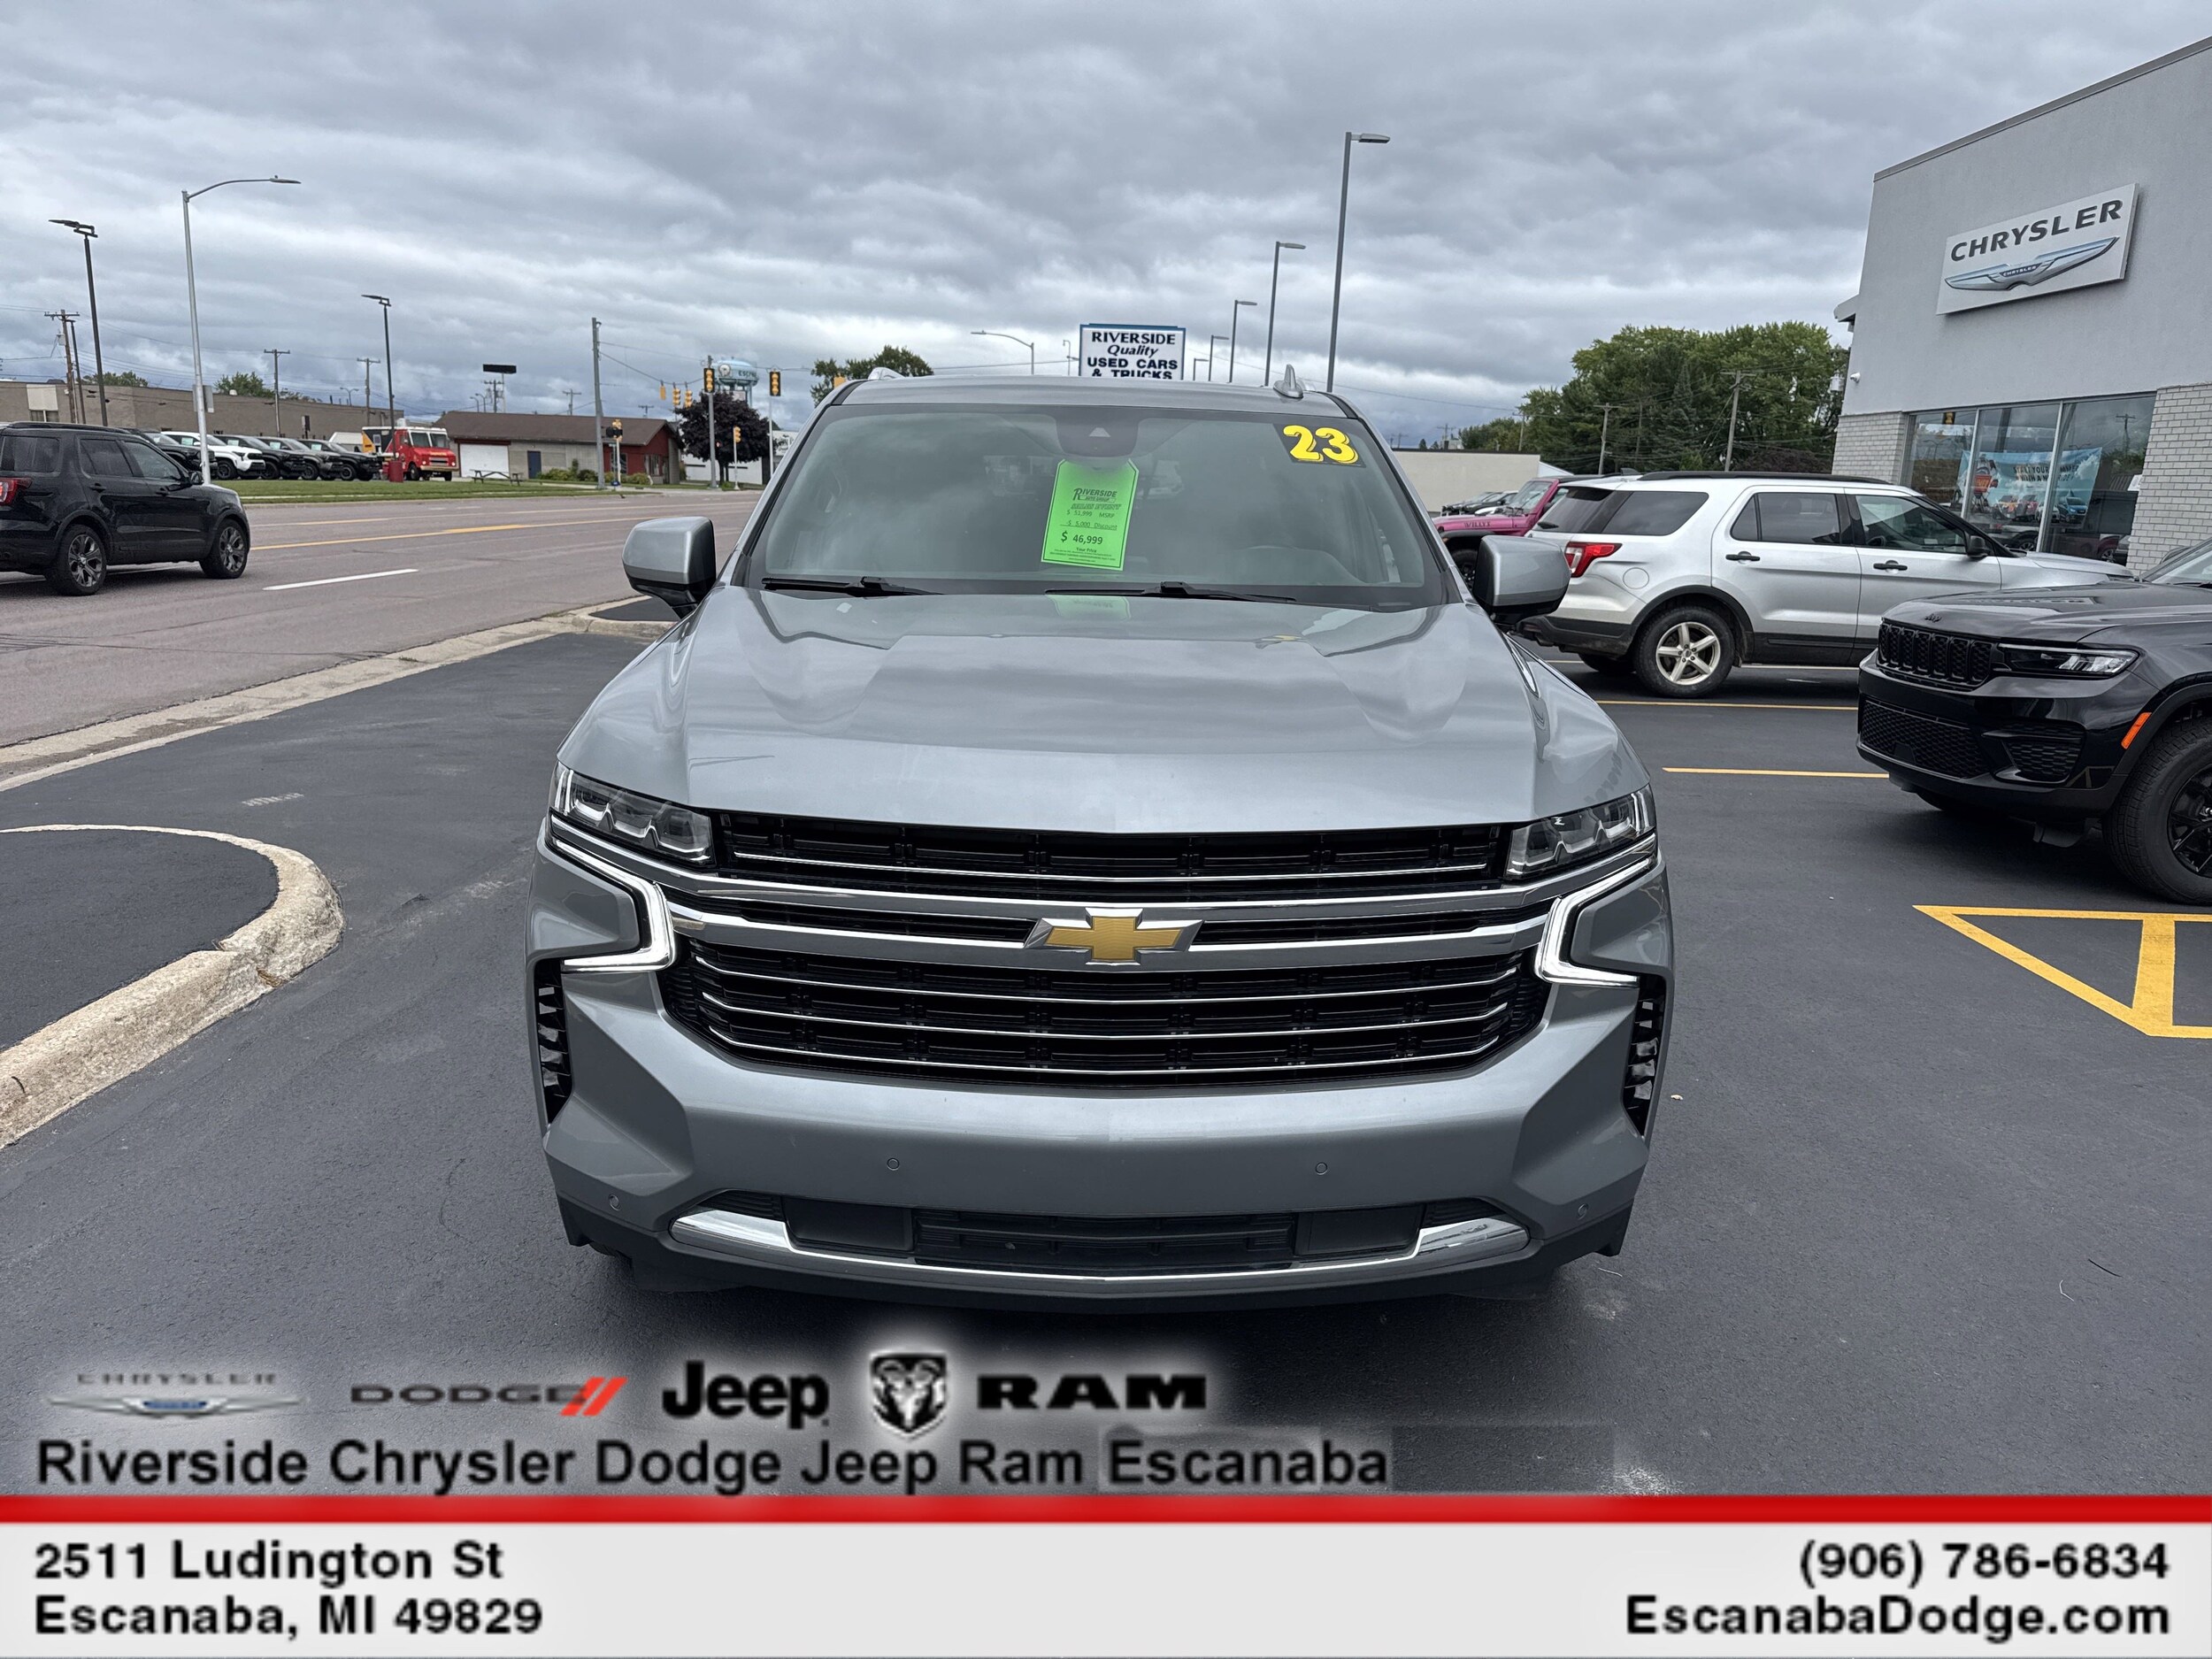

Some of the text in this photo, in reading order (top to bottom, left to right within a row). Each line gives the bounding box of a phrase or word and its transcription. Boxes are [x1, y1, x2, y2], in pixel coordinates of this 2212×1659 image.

[1950, 199, 2124, 262] CHRYSLER
[2002, 265, 2037, 277] CHRYSLER
[1092, 332, 1175, 345] RIVERSIDE
[1107, 344, 1159, 357] Quality
[1087, 357, 1178, 370] USED CARS
[1092, 368, 1102, 377] &
[1283, 425, 1359, 464] 23
[1072, 488, 1118, 501] RIVERSIDE
[1061, 530, 1103, 545] $ 46,999
